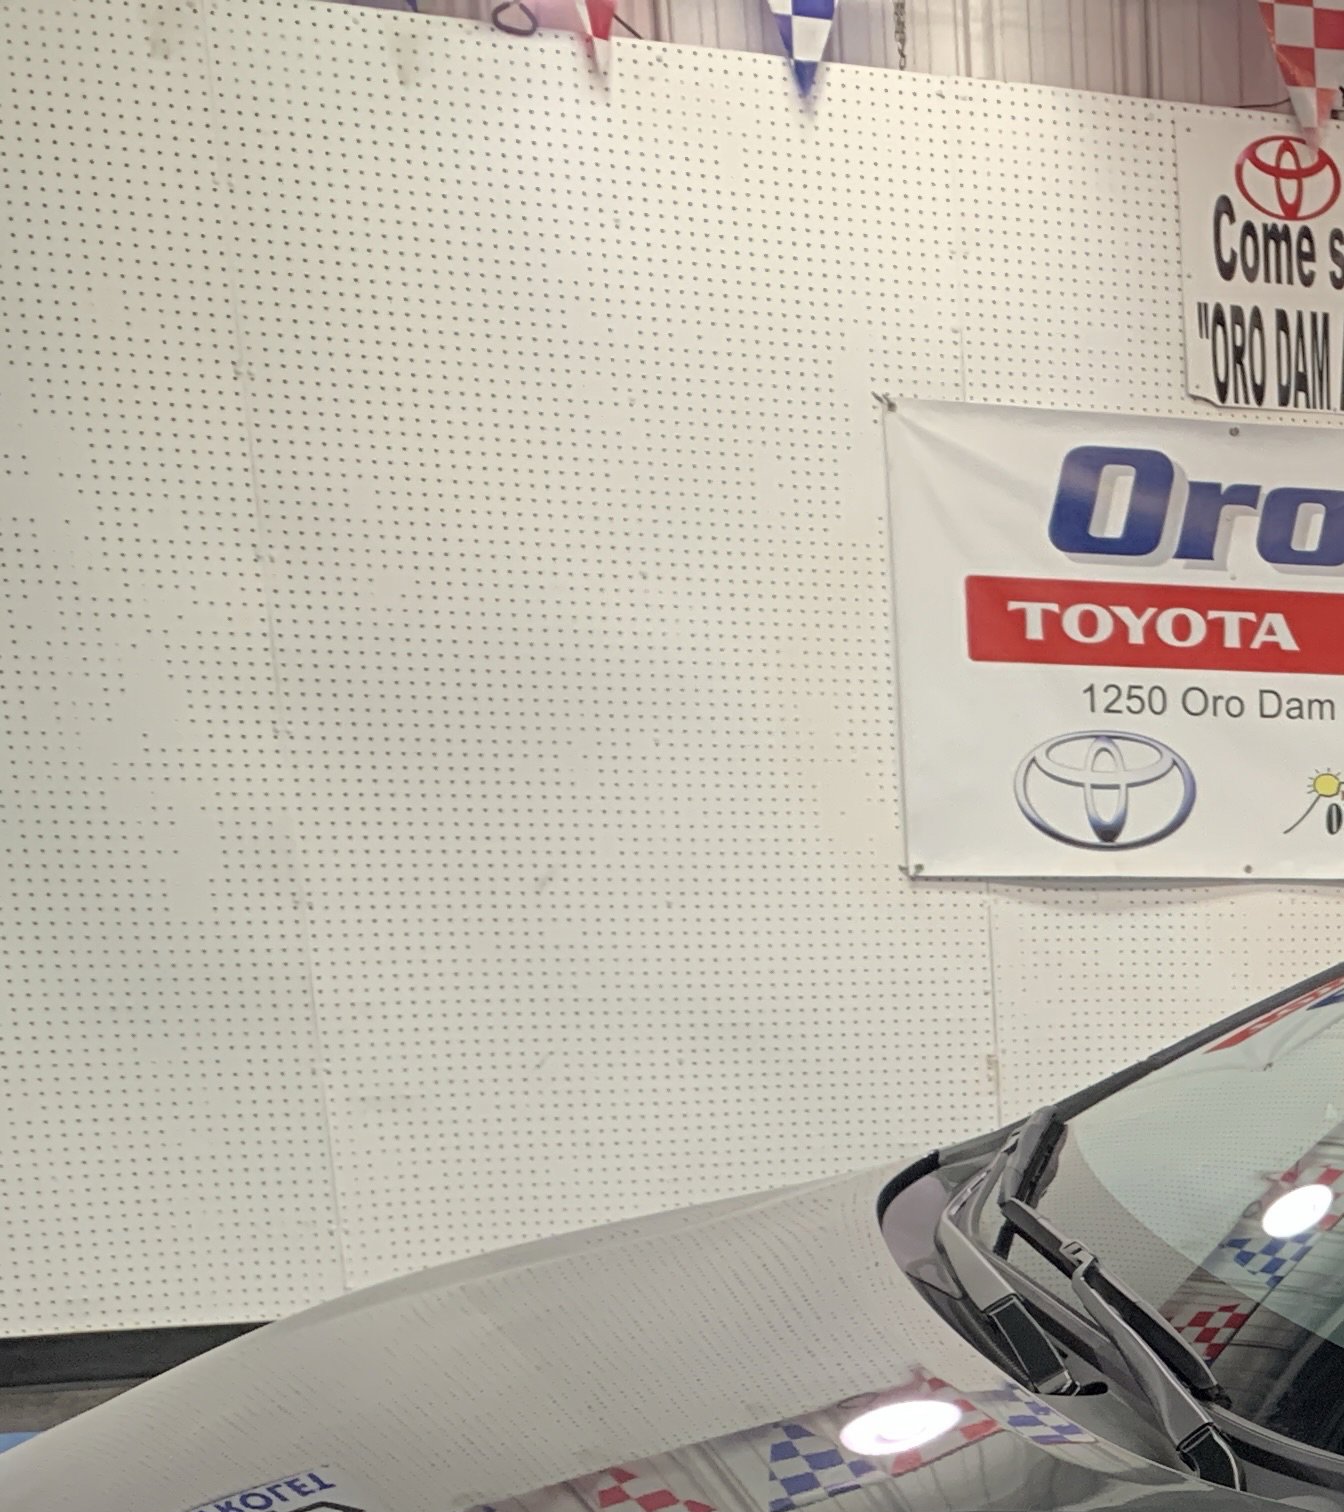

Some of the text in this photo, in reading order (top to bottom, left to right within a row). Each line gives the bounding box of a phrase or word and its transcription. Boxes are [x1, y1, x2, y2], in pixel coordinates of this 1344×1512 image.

[1213, 194, 1316, 288] Come
[1197, 300, 1266, 407] "ORO
[1275, 307, 1332, 410] DAM
[1007, 600, 1298, 653] TOYOTA
[1082, 684, 1168, 717] 1250
[1181, 688, 1246, 721] Oro
[1258, 690, 1337, 723] Dam
